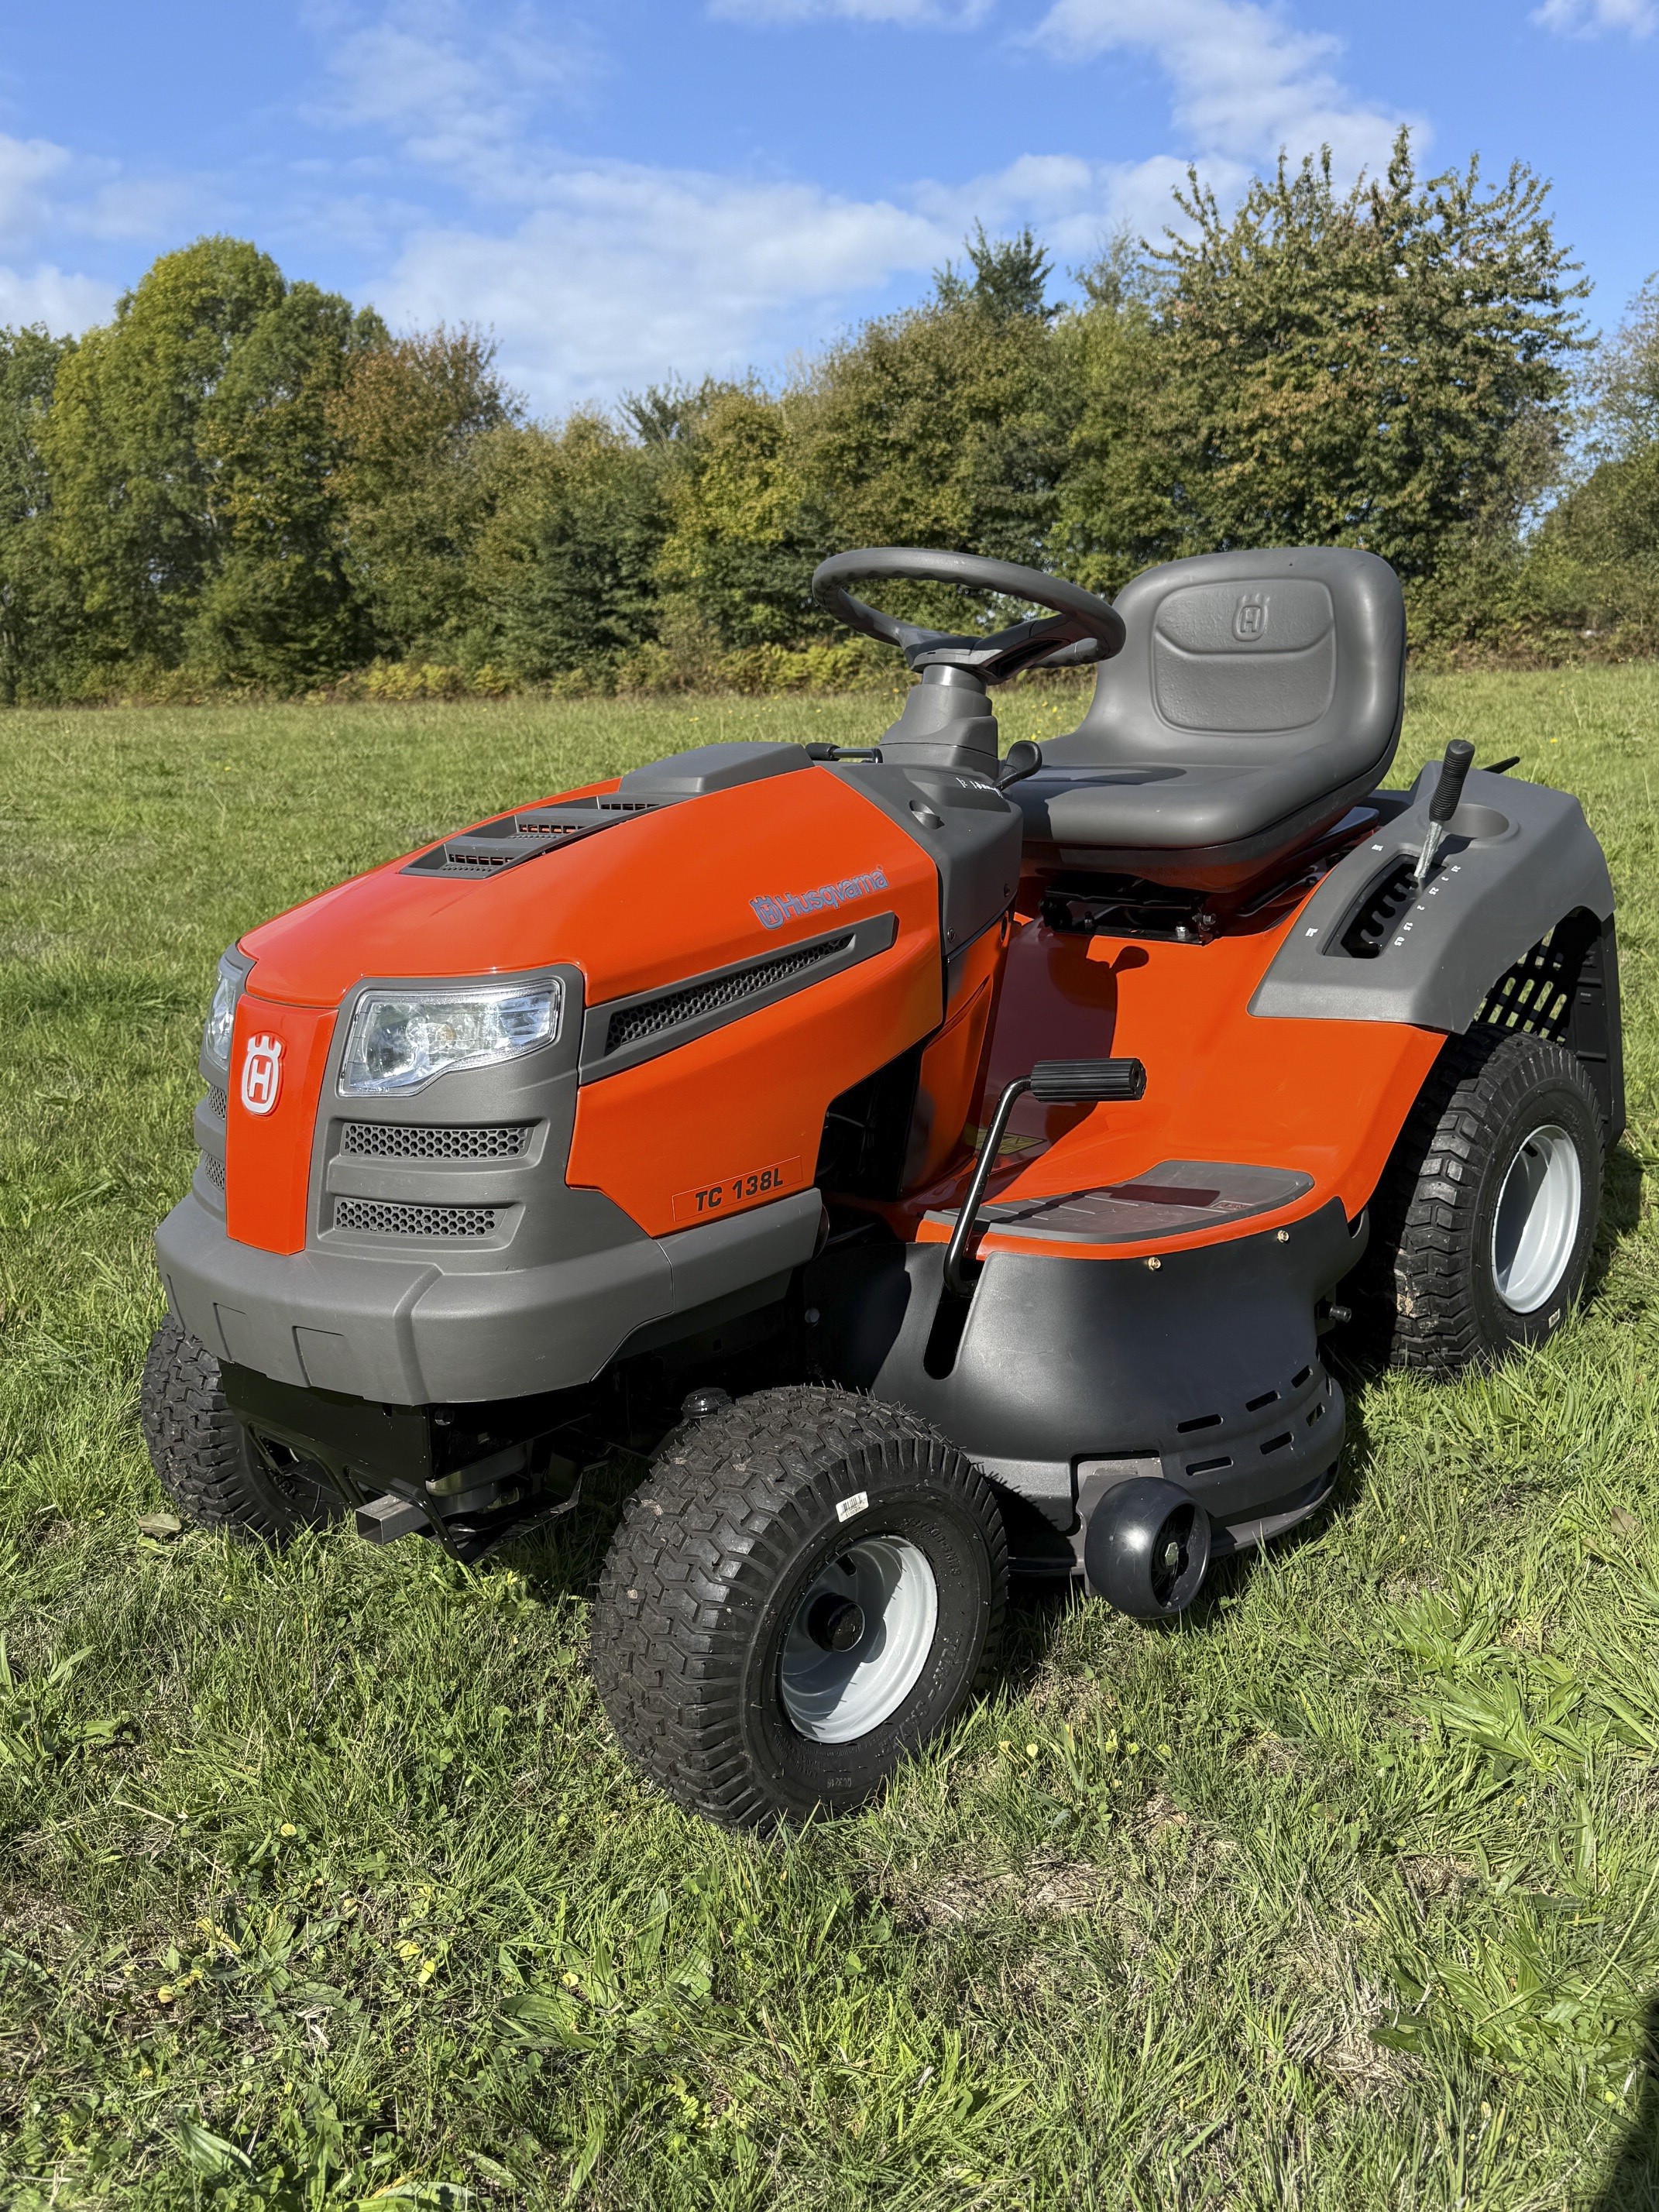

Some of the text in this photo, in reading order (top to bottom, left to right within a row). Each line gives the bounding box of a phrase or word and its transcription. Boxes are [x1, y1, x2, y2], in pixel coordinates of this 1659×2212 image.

[776, 871, 888, 919] Husqvarna
[695, 1167, 784, 1211] TC 138L
